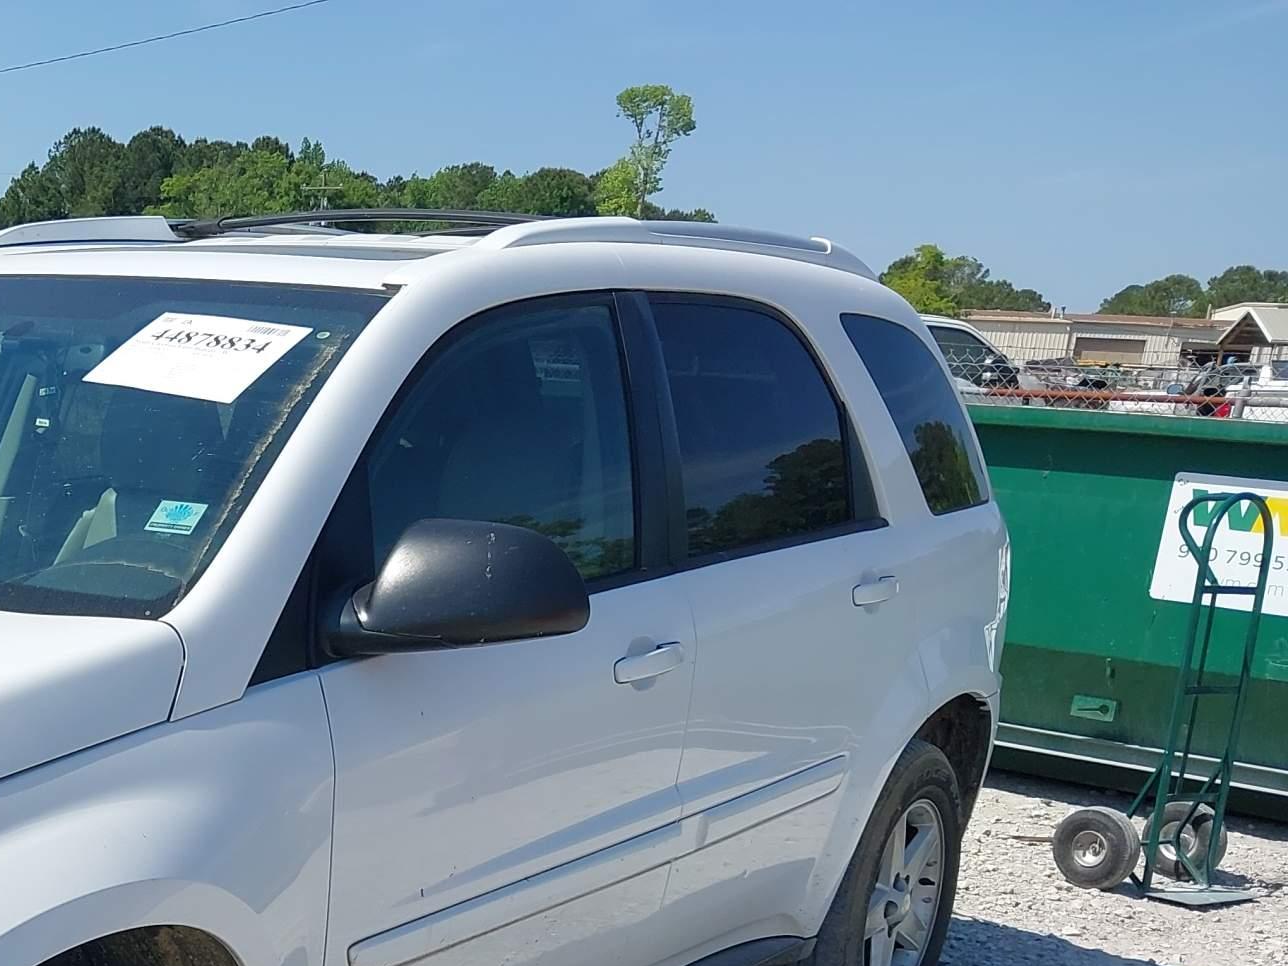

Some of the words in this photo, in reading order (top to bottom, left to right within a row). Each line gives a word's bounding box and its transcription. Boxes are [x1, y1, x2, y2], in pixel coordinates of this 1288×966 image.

[151, 328, 273, 354] 44878834
[1178, 543, 1218, 562] 90
[1225, 549, 1264, 568] 799
[1272, 555, 1288, 572] 5
